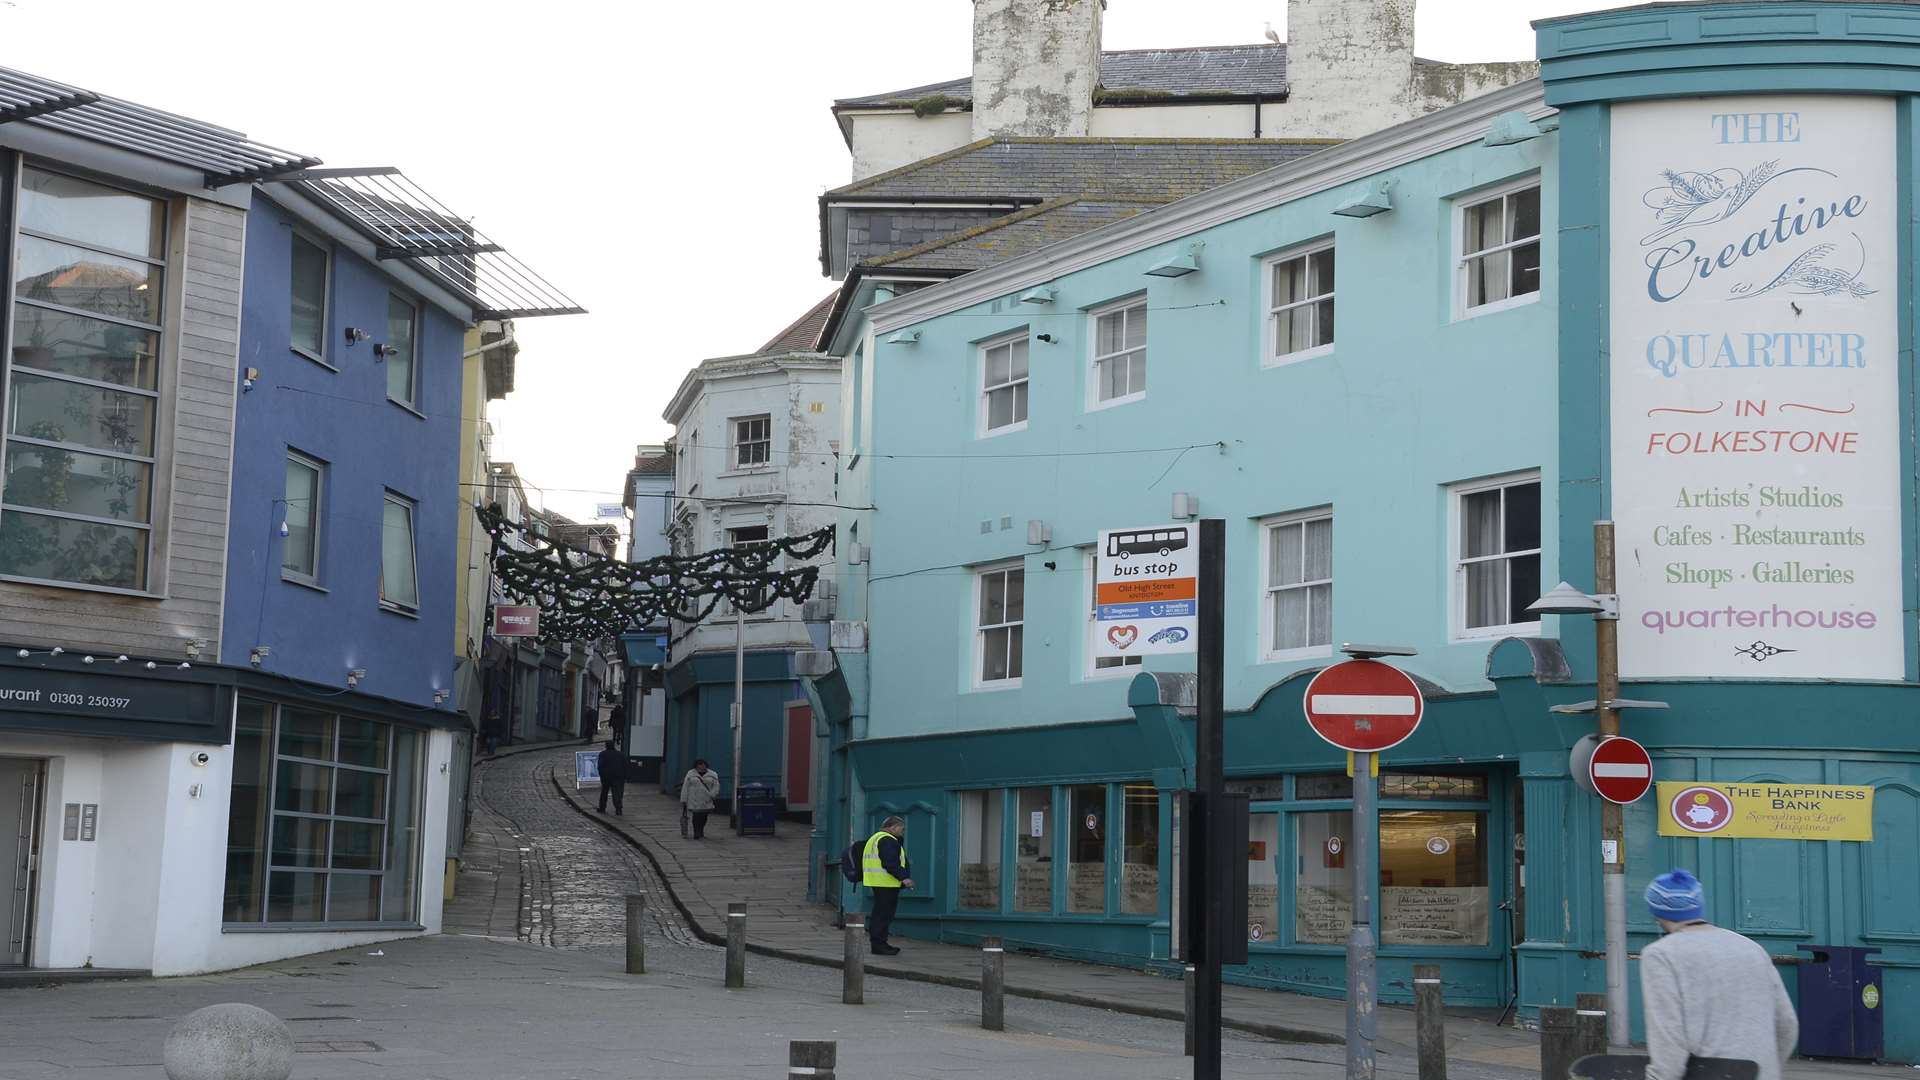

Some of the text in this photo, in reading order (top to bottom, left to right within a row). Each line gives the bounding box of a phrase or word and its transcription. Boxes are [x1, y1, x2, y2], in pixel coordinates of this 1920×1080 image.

[1711, 112, 1801, 145] THE
[1645, 194, 1868, 303] Creative
[1646, 331, 1867, 378] QUARTER
[1735, 399, 1767, 417] IN
[1647, 430, 1859, 455] FOLKESTONE
[1759, 486, 1844, 508] Studios
[1653, 524, 1866, 546] Cafes Restaurants
[1113, 563, 1178, 577] bus stop
[1666, 561, 1855, 589] Shops Galleries
[1641, 604, 1877, 634] quarterhouse
[50, 692, 84, 705] 01303
[87, 695, 131, 708] 250397
[1772, 799, 1821, 810] BANK
